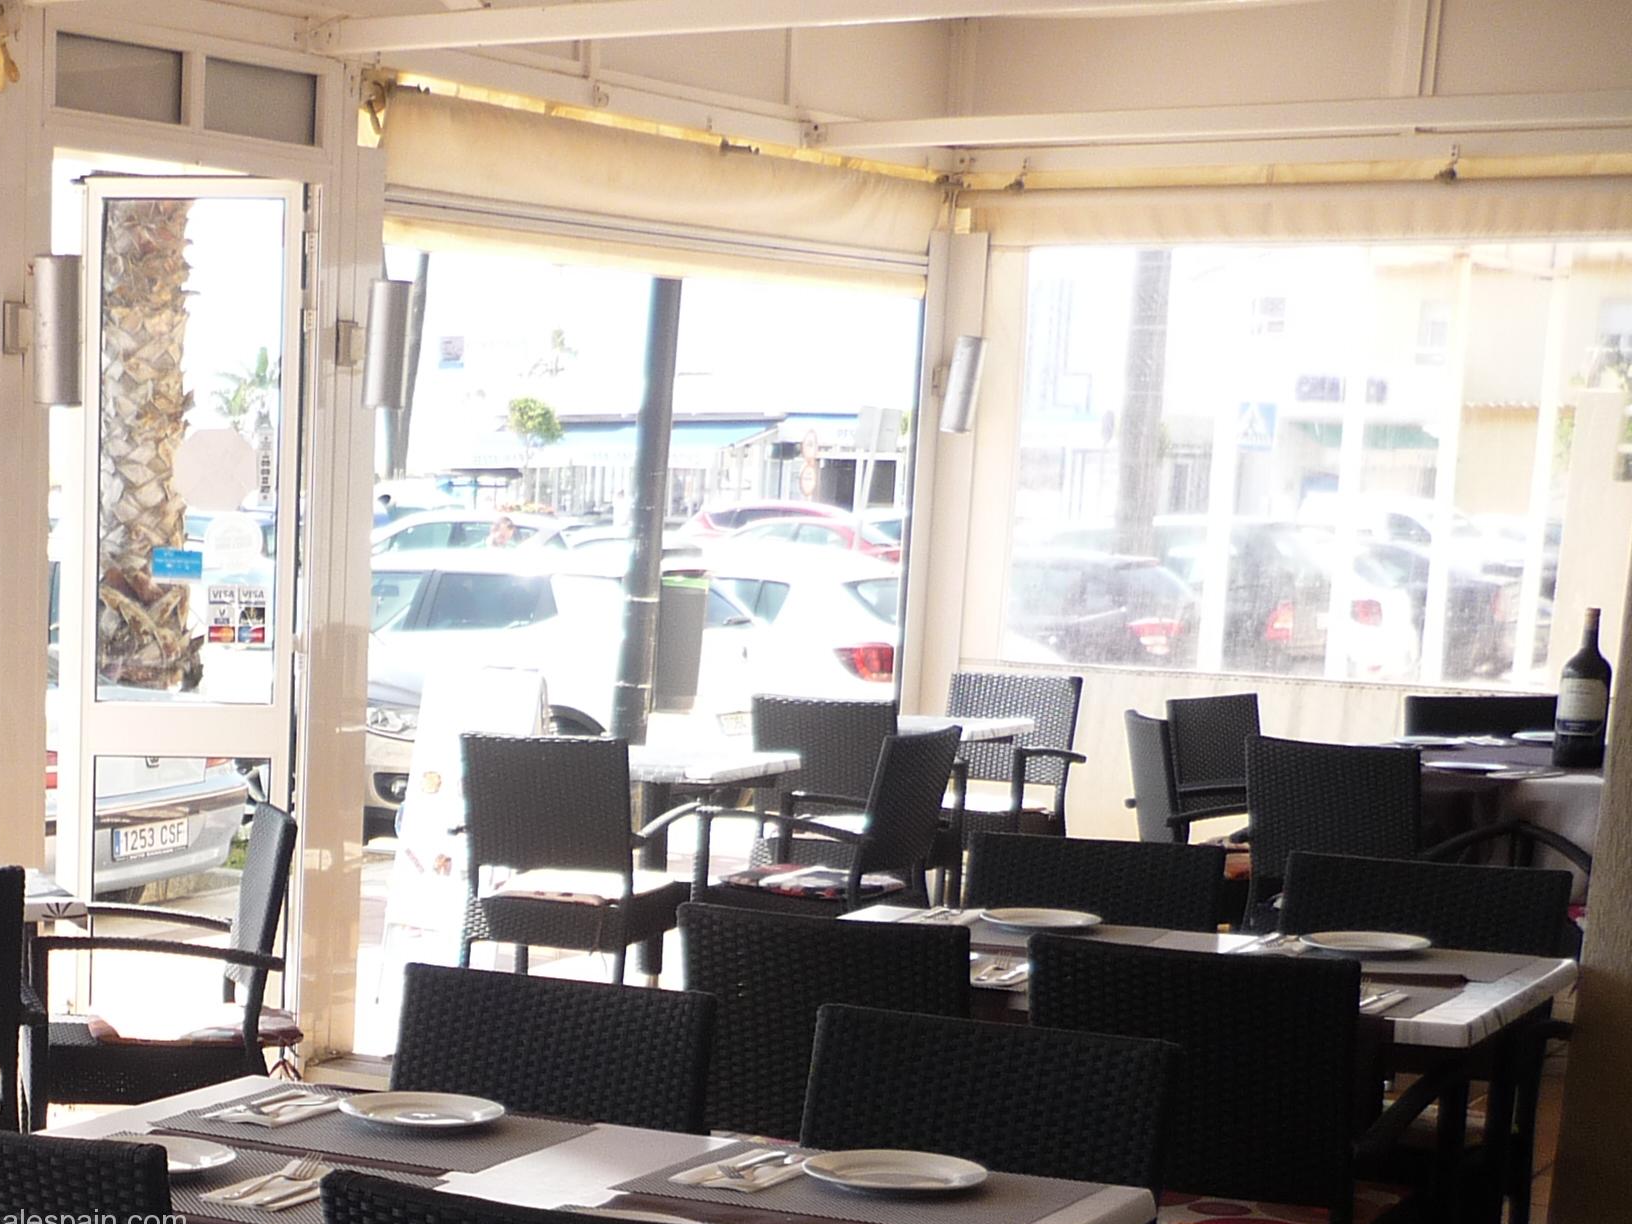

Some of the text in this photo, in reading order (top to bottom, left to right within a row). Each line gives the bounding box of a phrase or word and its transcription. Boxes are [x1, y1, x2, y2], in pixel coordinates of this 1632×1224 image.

[212, 589, 235, 599] VISA
[242, 589, 265, 599] VISA
[123, 821, 184, 853] 1253 CSF
